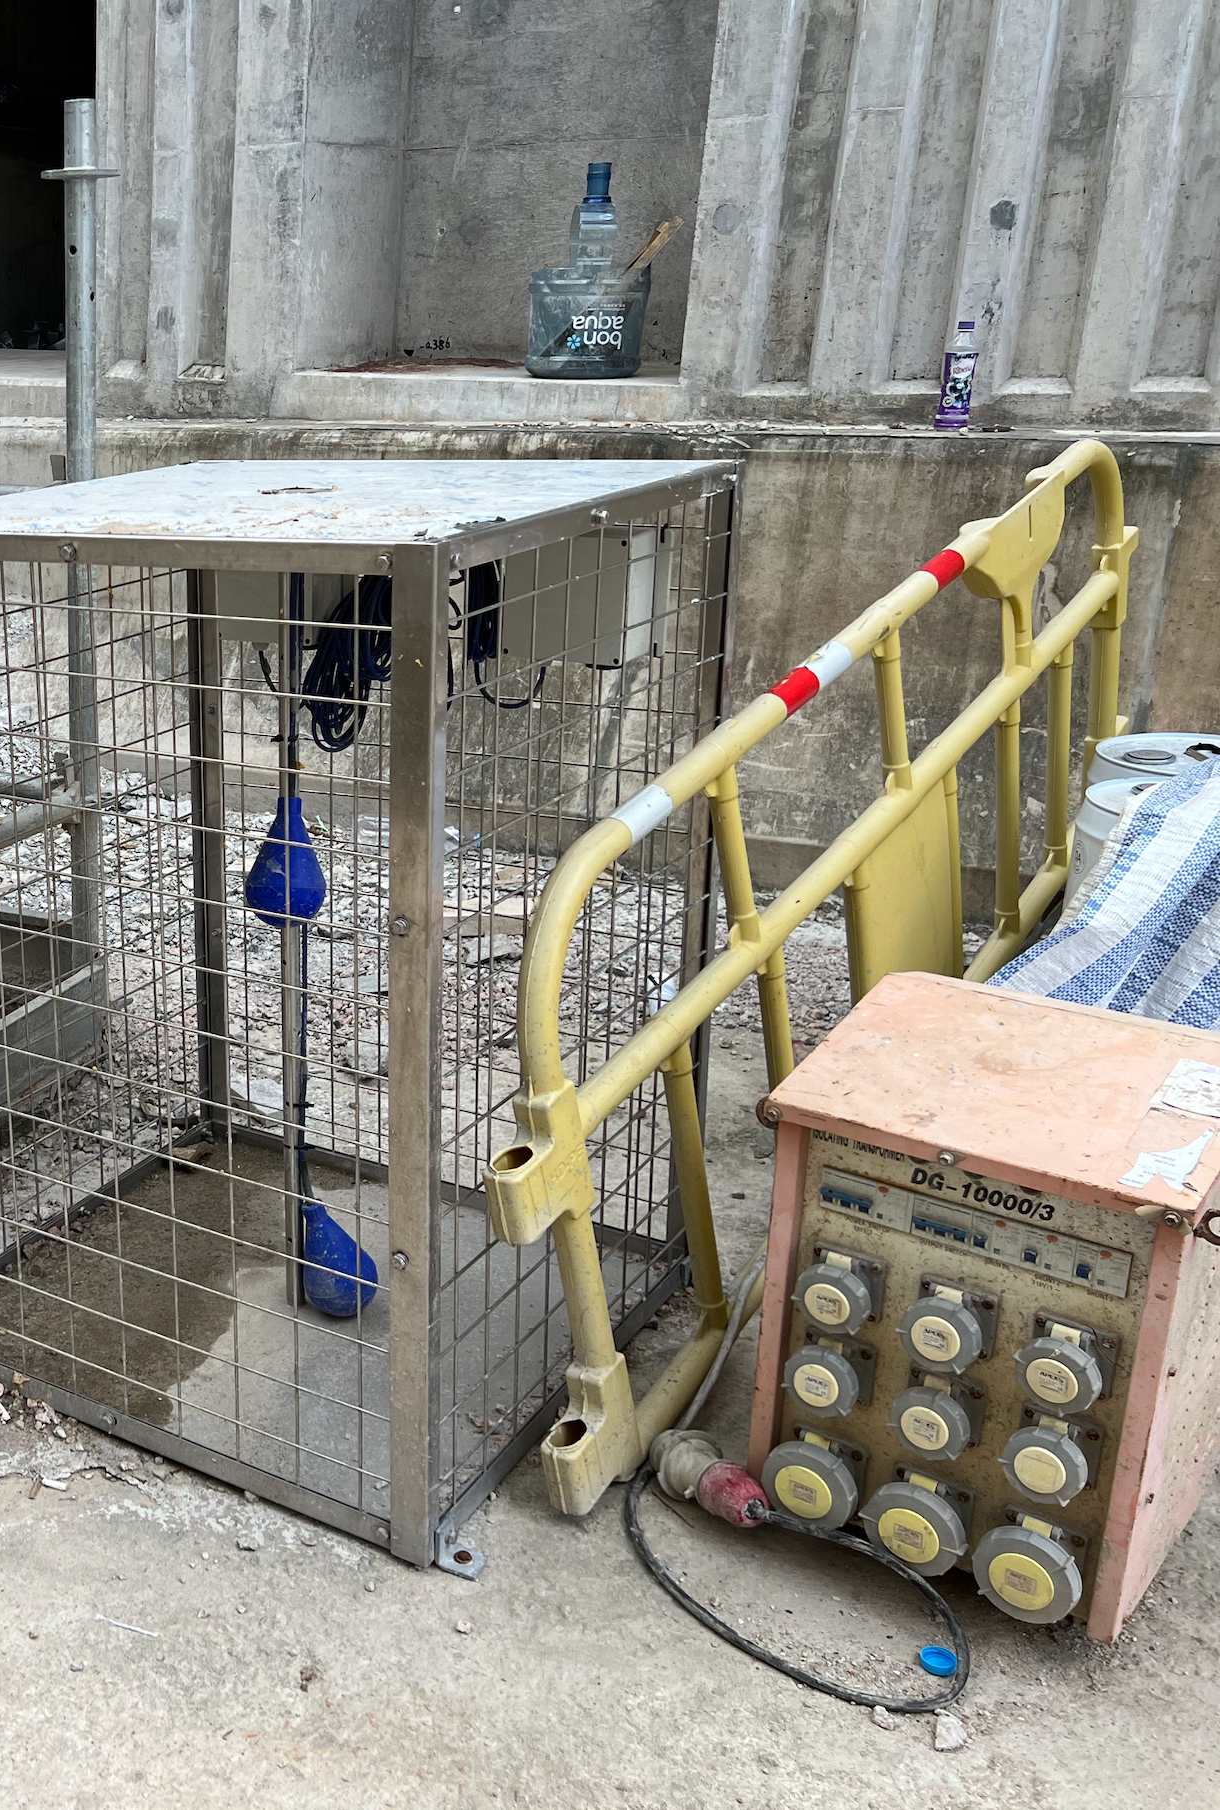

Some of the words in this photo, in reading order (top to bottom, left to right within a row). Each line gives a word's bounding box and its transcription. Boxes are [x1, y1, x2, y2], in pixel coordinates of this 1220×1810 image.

[572, 312, 624, 330] aqua
[583, 331, 622, 350] bon
[910, 1167, 1056, 1221] DG-10000/3
